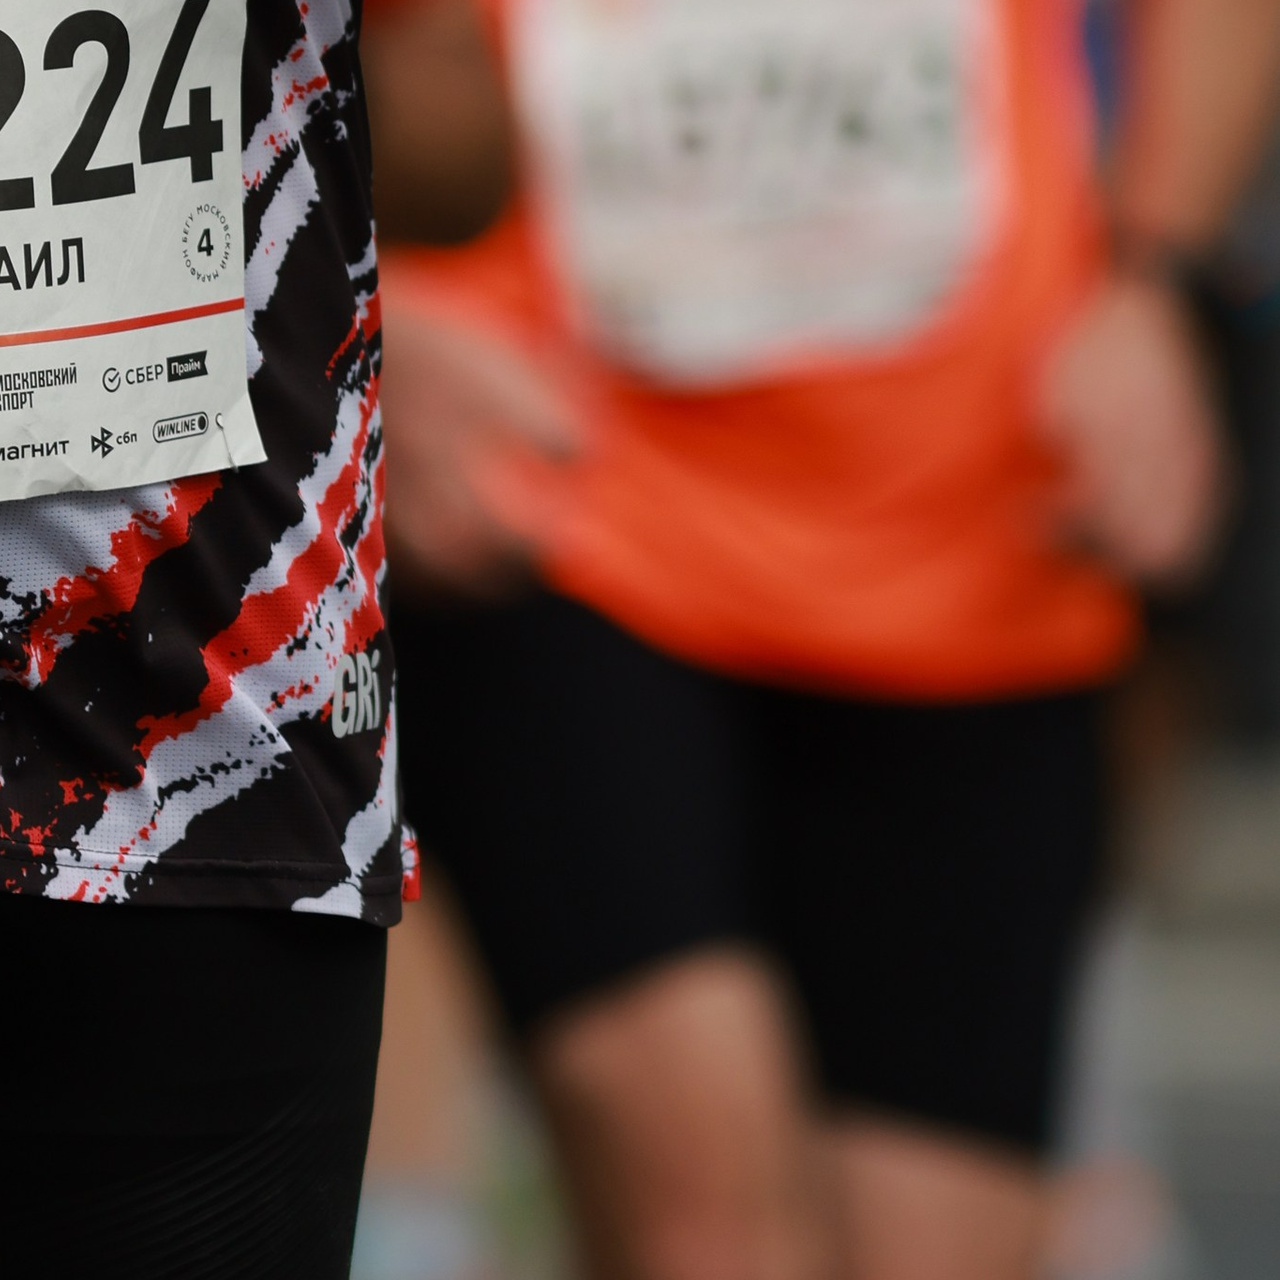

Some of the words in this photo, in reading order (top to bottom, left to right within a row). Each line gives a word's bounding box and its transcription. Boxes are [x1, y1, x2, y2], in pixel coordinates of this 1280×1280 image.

[197, 228, 214, 256] 4
[125, 364, 164, 385] СБЕР
[171, 358, 201, 376] Прайм
[157, 418, 196, 437] WINLINE
